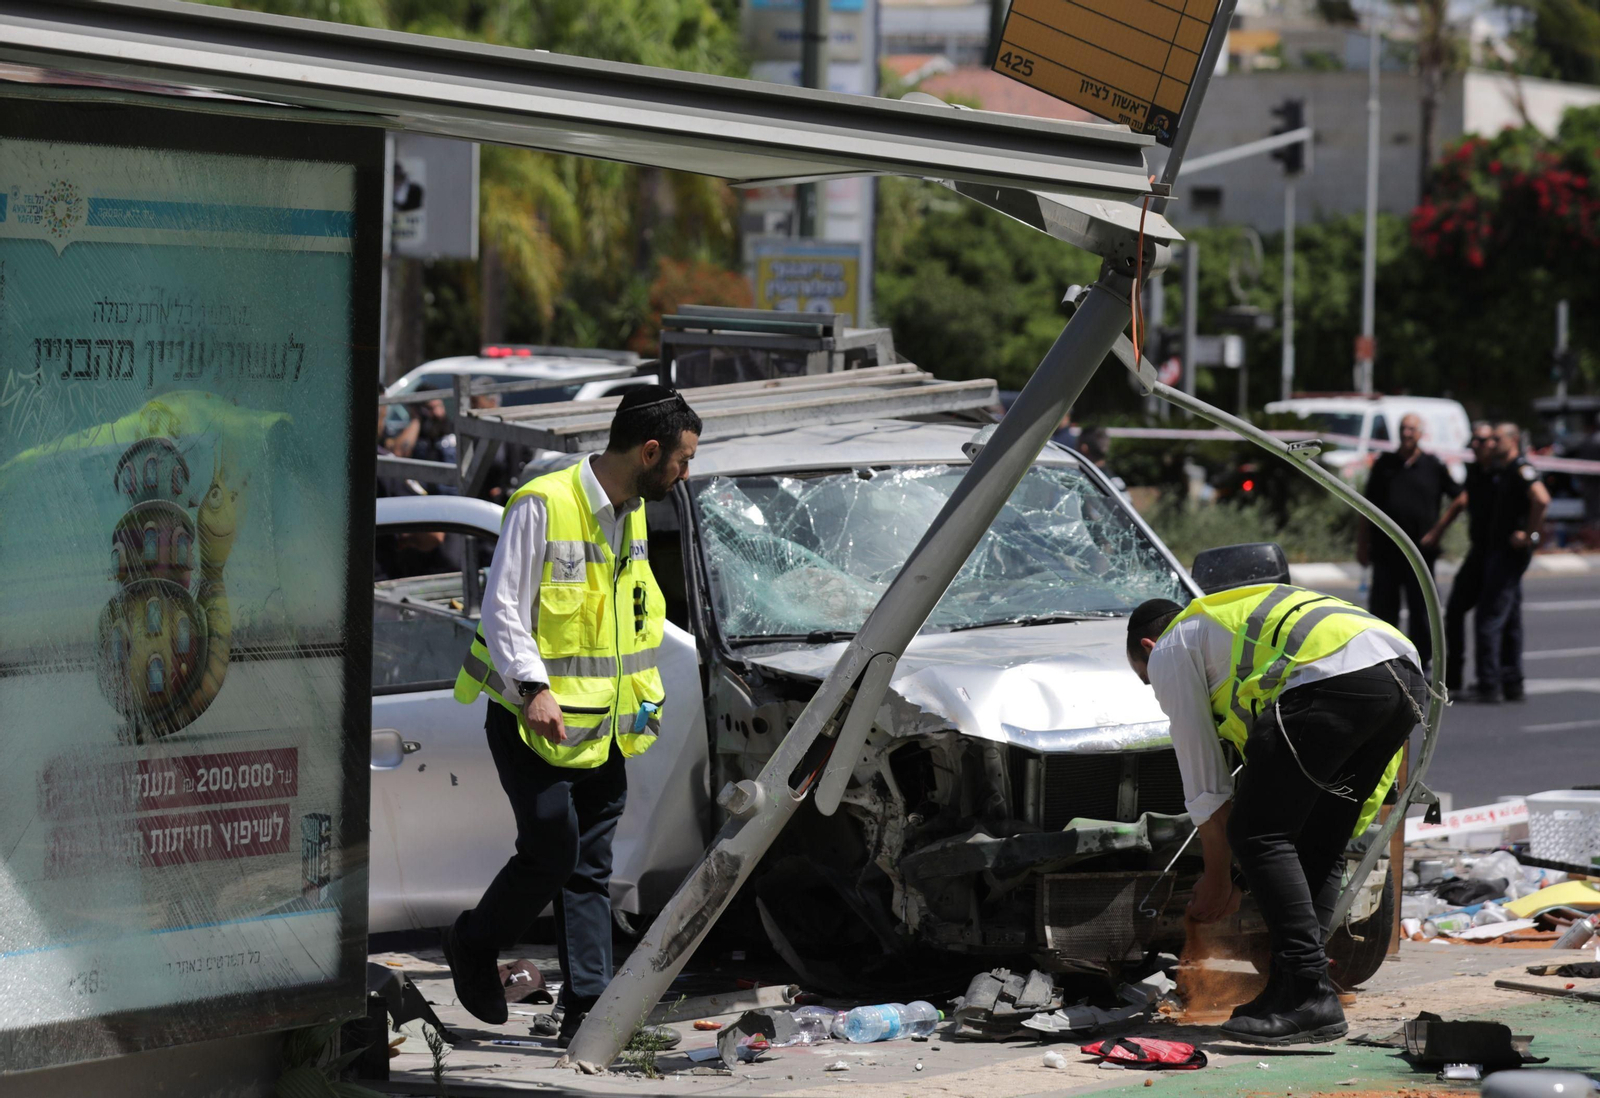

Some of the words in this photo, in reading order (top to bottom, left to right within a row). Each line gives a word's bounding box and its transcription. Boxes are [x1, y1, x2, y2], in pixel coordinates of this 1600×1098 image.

[1000, 51, 1035, 77] 425
[1079, 79, 1110, 101] לציון
[1111, 92, 1149, 118] ראשון
[24, 194, 35, 204] TEL
[35, 193, 44, 204] תל
[92, 296, 134, 324] יכולה
[137, 301, 170, 325] אחת
[174, 298, 193, 325] כל
[34, 337, 135, 389] מהבניין
[145, 339, 204, 390] עניין
[277, 768, 292, 785] עד
[150, 823, 212, 854] חזיתות
[219, 812, 284, 851] לשיפוץ
[248, 949, 261, 964] כל
